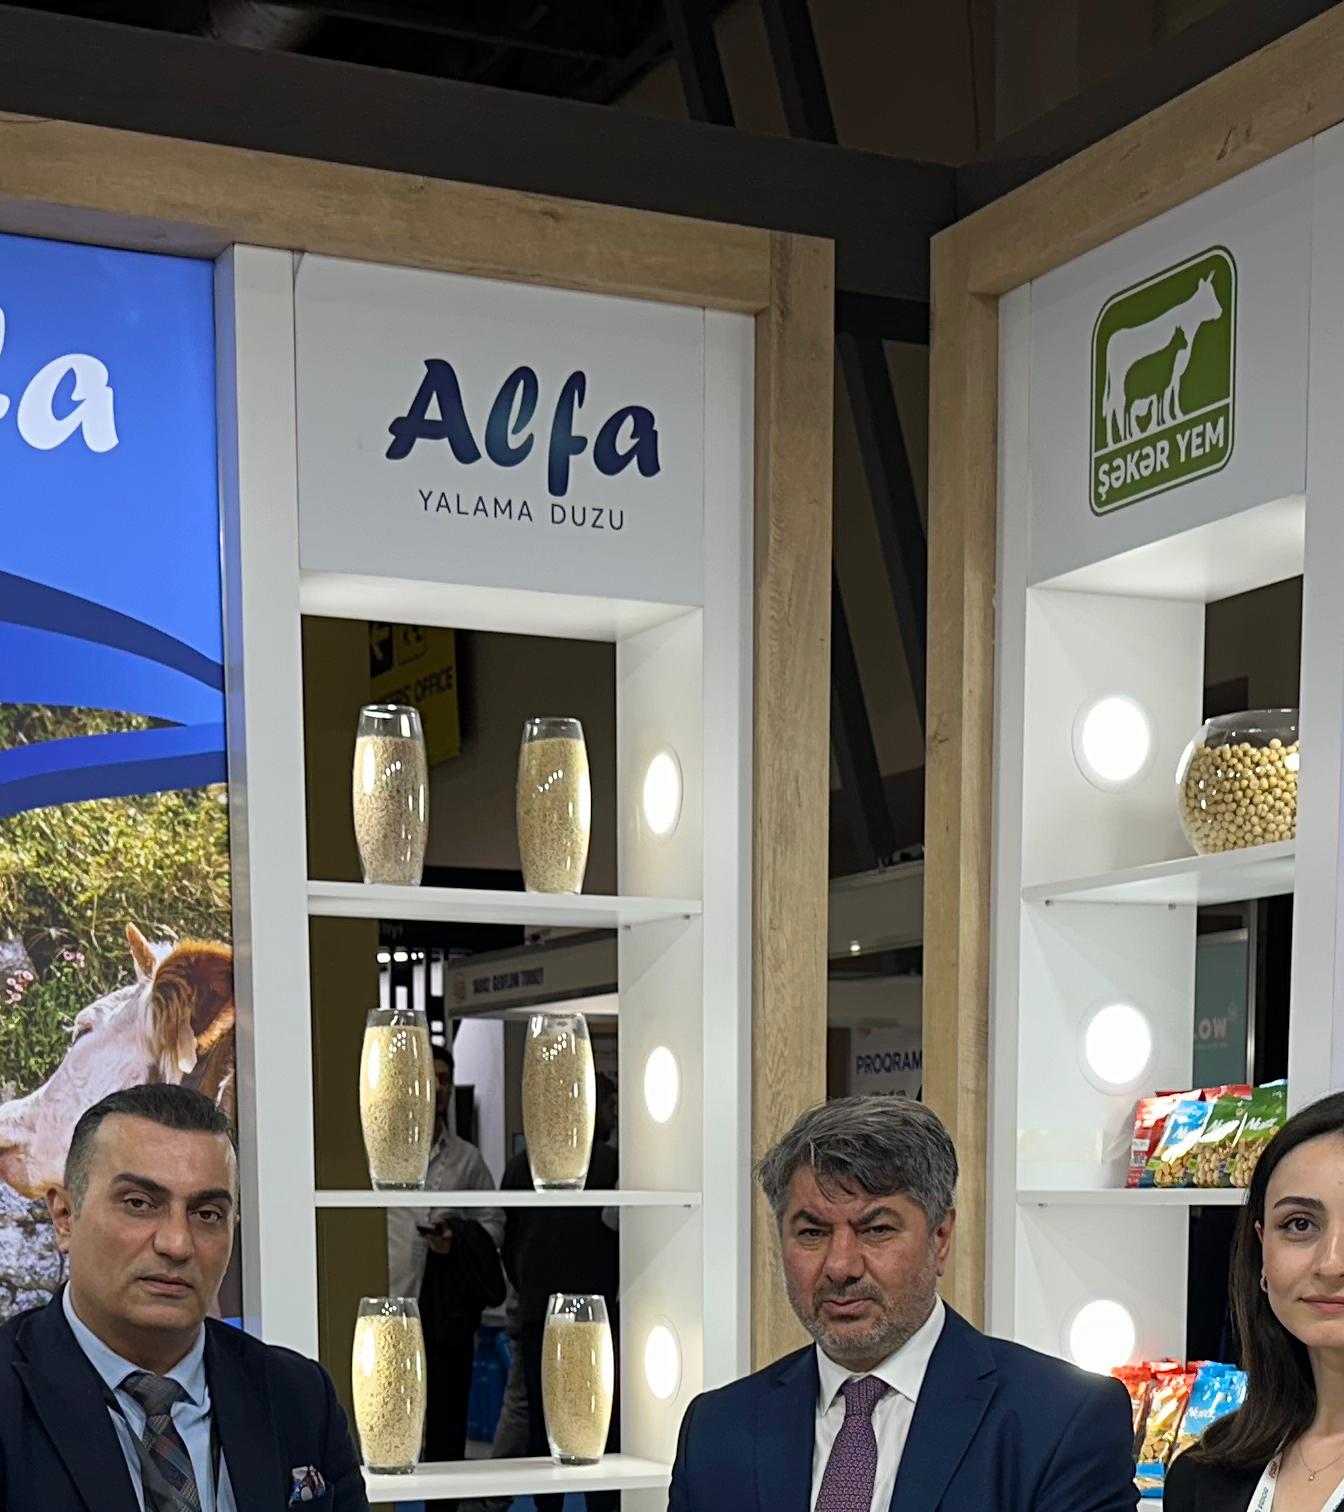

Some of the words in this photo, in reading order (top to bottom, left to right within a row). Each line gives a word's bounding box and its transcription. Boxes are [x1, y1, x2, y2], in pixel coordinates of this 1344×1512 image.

[385, 358, 661, 497] Alfa
[1098, 439, 1170, 501] ŞƏKƏR
[1176, 416, 1226, 464] YEM
[418, 489, 533, 522] YALAMA
[550, 503, 626, 531] DUZU
